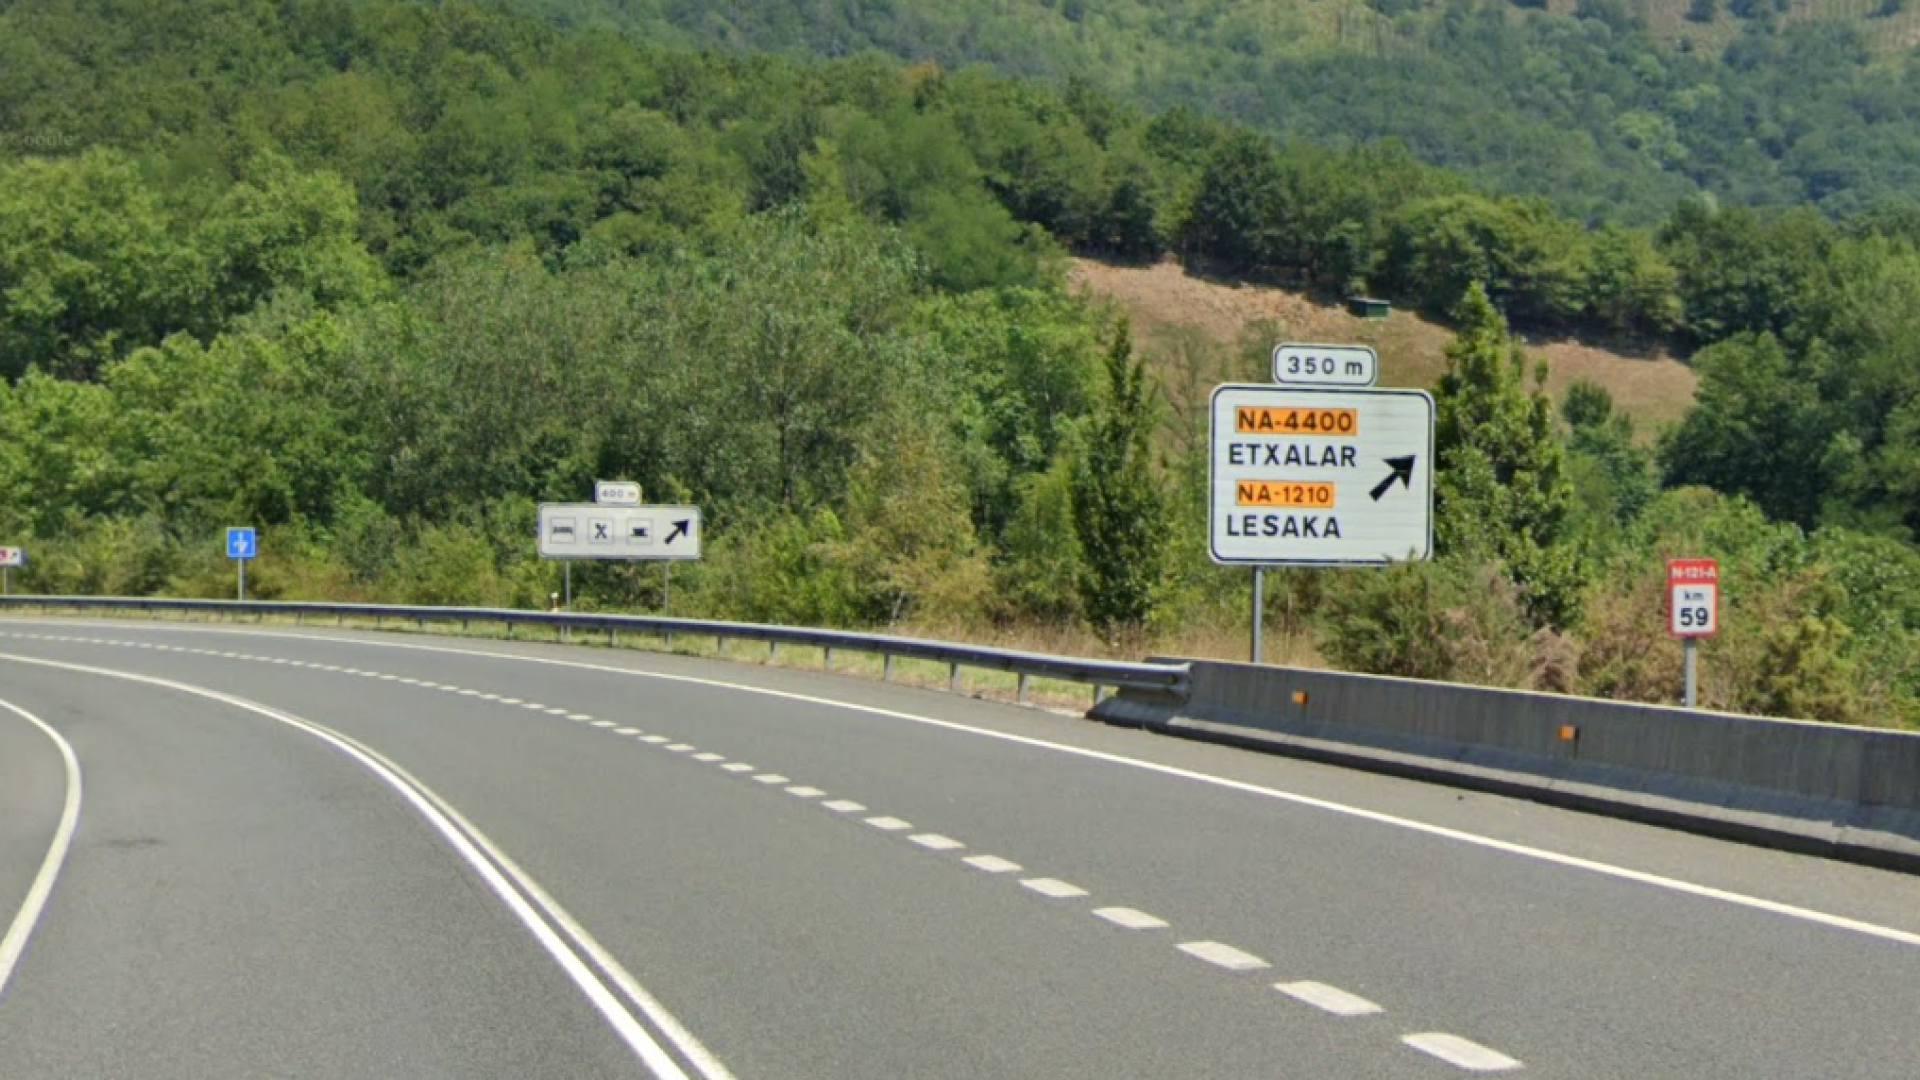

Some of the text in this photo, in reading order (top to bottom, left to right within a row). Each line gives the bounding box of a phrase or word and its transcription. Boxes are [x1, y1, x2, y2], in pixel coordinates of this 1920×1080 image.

[1288, 357, 1363, 376] 350 m
[1237, 408, 1353, 432] NA-4400
[1229, 443, 1356, 467] ETXALAR
[1237, 484, 1330, 503] NA-1210
[1227, 514, 1342, 538] LESAKA
[1671, 566, 1716, 578] N-121-A
[1684, 590, 1704, 600] km
[1680, 607, 1709, 627] 59
